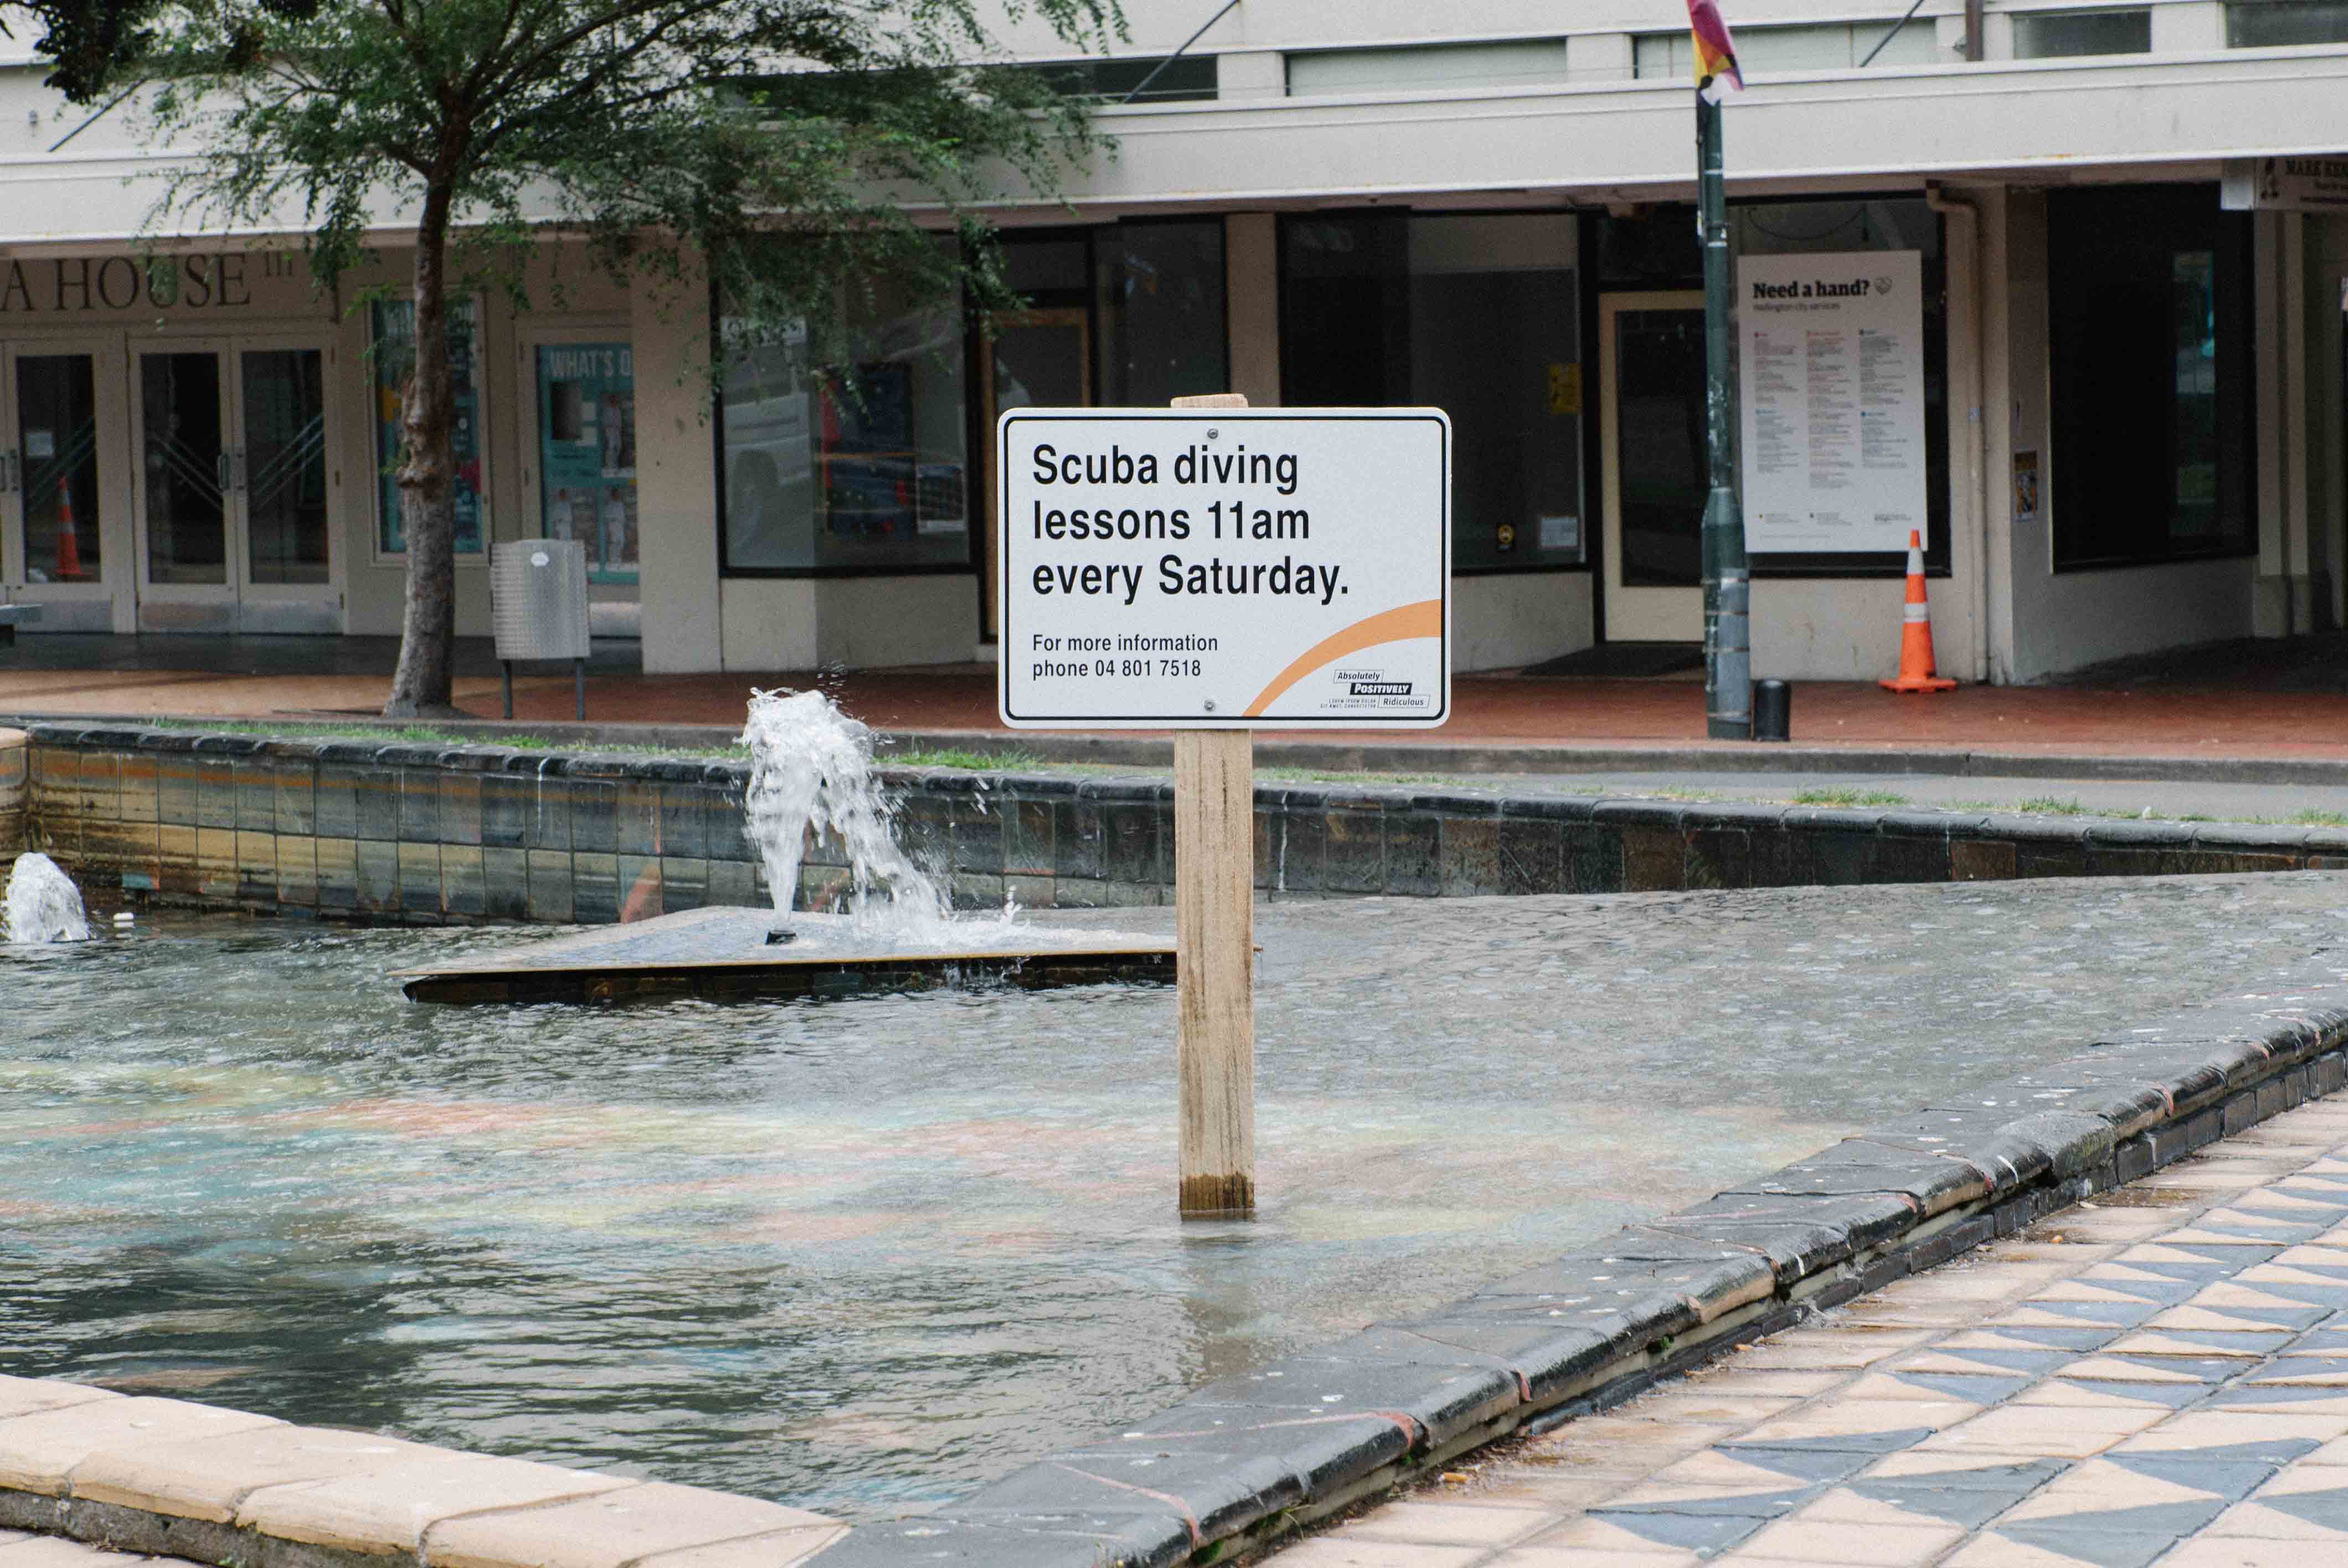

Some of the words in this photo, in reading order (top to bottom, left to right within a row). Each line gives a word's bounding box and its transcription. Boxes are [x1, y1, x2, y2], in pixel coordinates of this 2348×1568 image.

[55, 252, 250, 310] HOUSE
[1752, 281, 1799, 299] Need
[1801, 283, 1813, 298] a
[1815, 278, 1870, 297] hand?
[550, 349, 614, 378] WHAT'S
[1033, 443, 1158, 485] Scuba
[1174, 444, 1297, 496] diving
[1034, 500, 1190, 540] lessons
[1207, 501, 1309, 540] 11am
[1033, 564, 1144, 606] every
[1159, 554, 1348, 606] Saturday.
[1033, 634, 1062, 651] For
[1068, 638, 1111, 652] more
[1118, 633, 1218, 651] information
[1033, 659, 1088, 681] phone
[1095, 659, 1115, 677] 04
[1122, 659, 1150, 677] 801
[1160, 659, 1201, 677] 7518
[1337, 671, 1381, 682] Absolutely
[1354, 683, 1409, 694] POSITIVELY
[1383, 698, 1424, 706] Ridiculous
